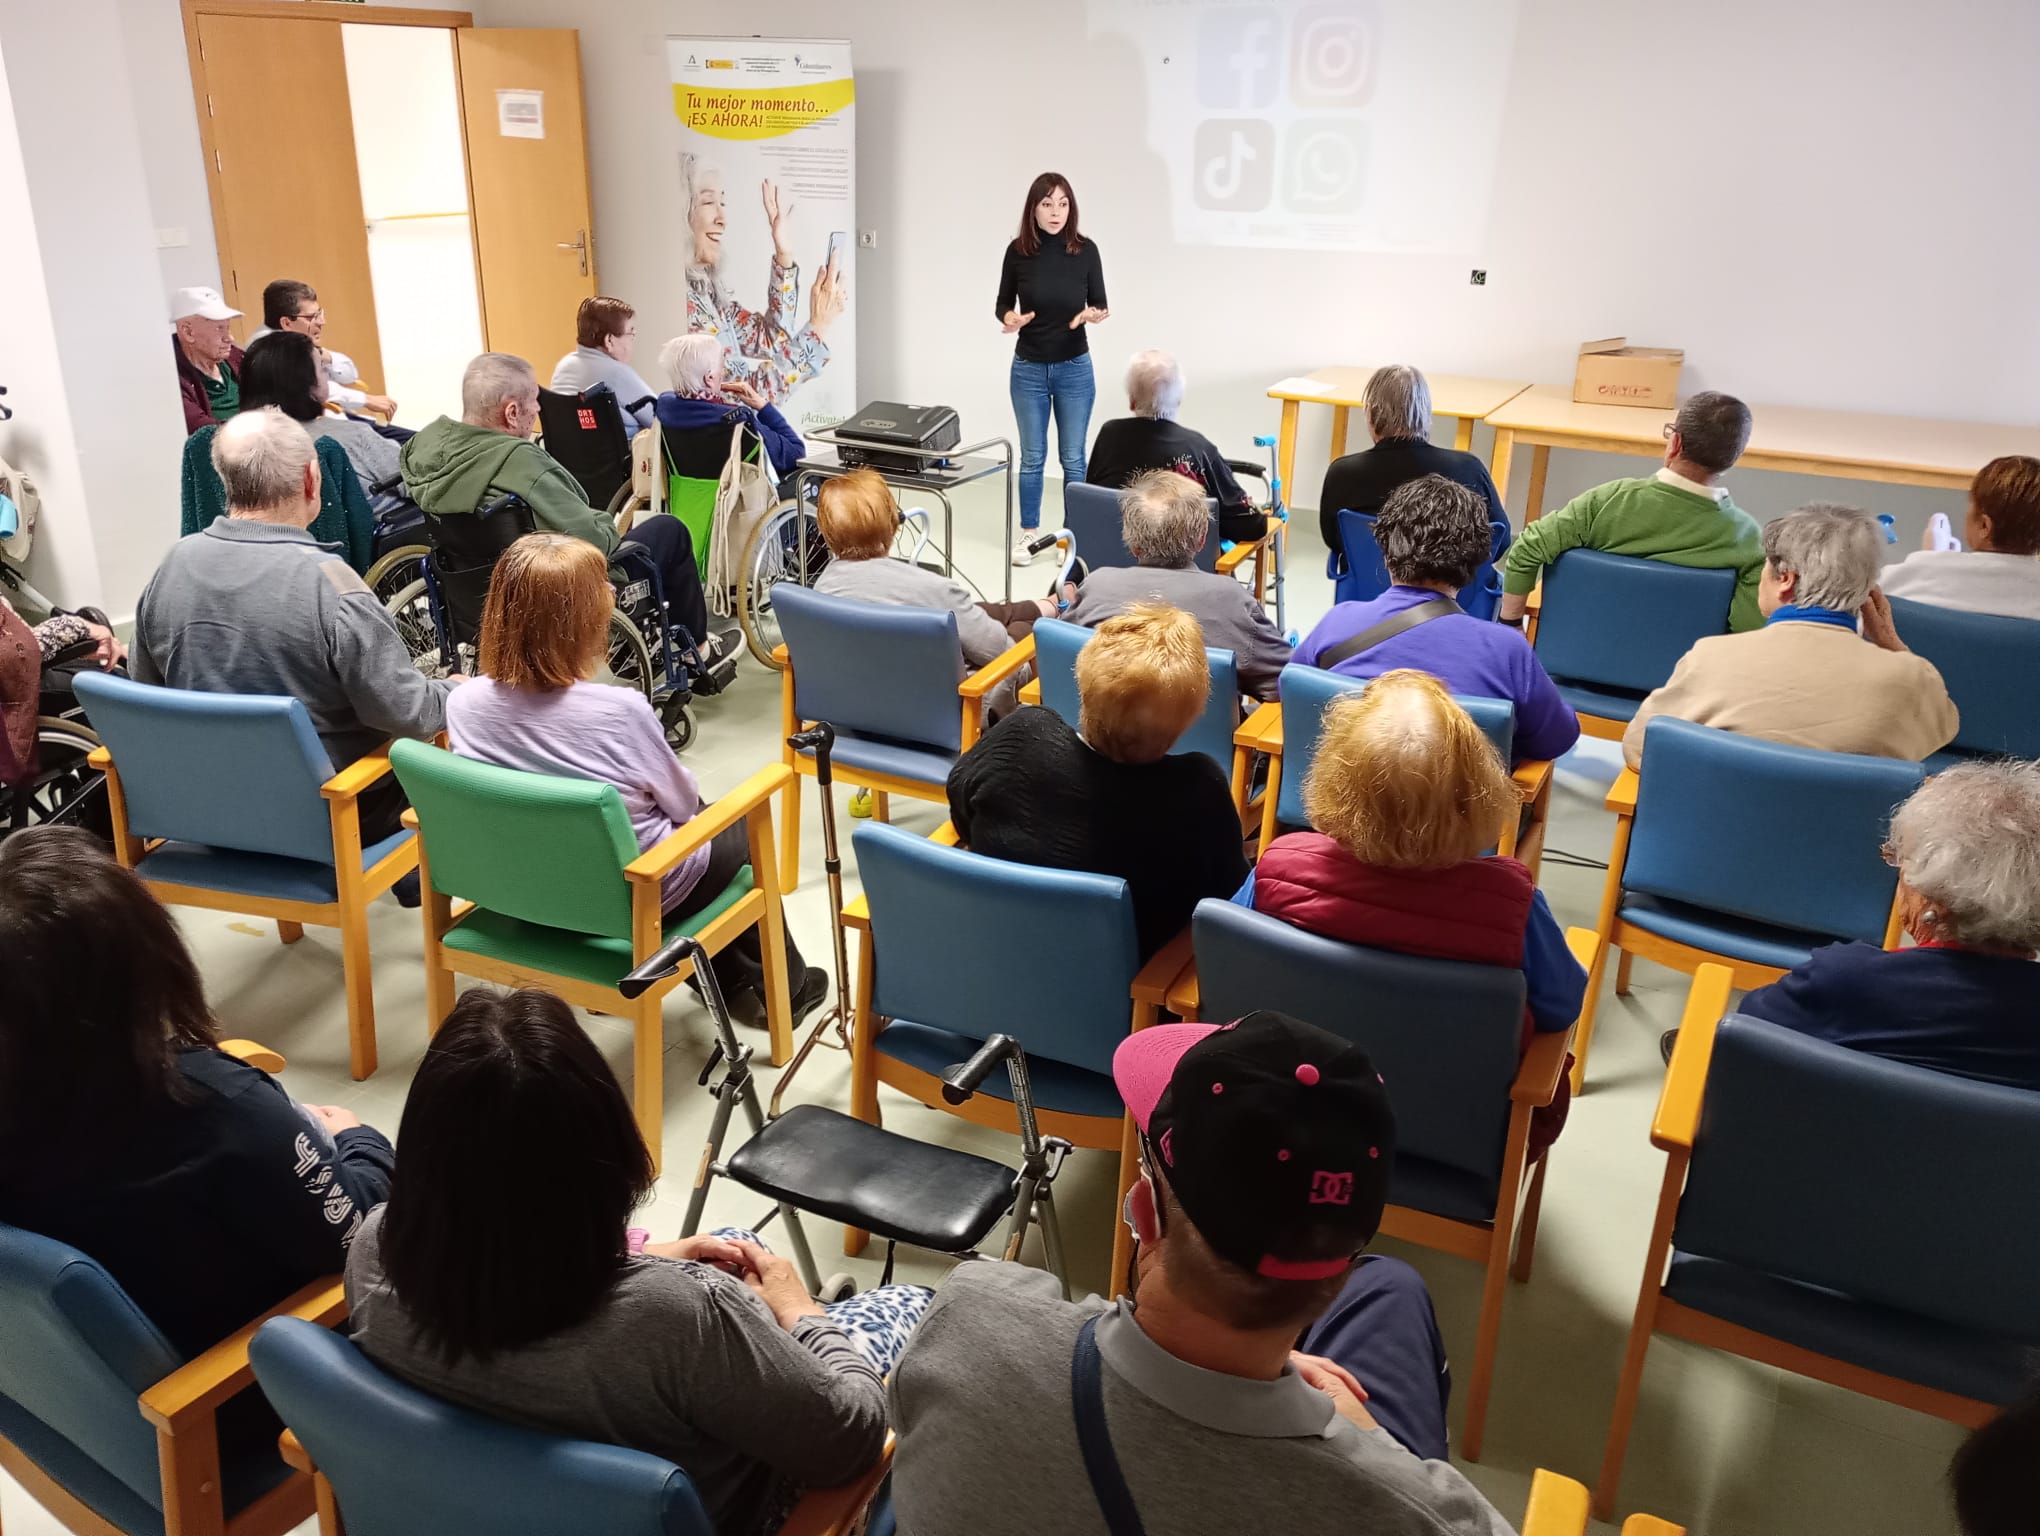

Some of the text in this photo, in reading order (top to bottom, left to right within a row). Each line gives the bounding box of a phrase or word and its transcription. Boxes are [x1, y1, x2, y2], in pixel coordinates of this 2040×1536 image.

[687, 93, 829, 113] Tu mejor momento...
[687, 112, 707, 128] ¡ES
[711, 111, 763, 128] AHORA!
